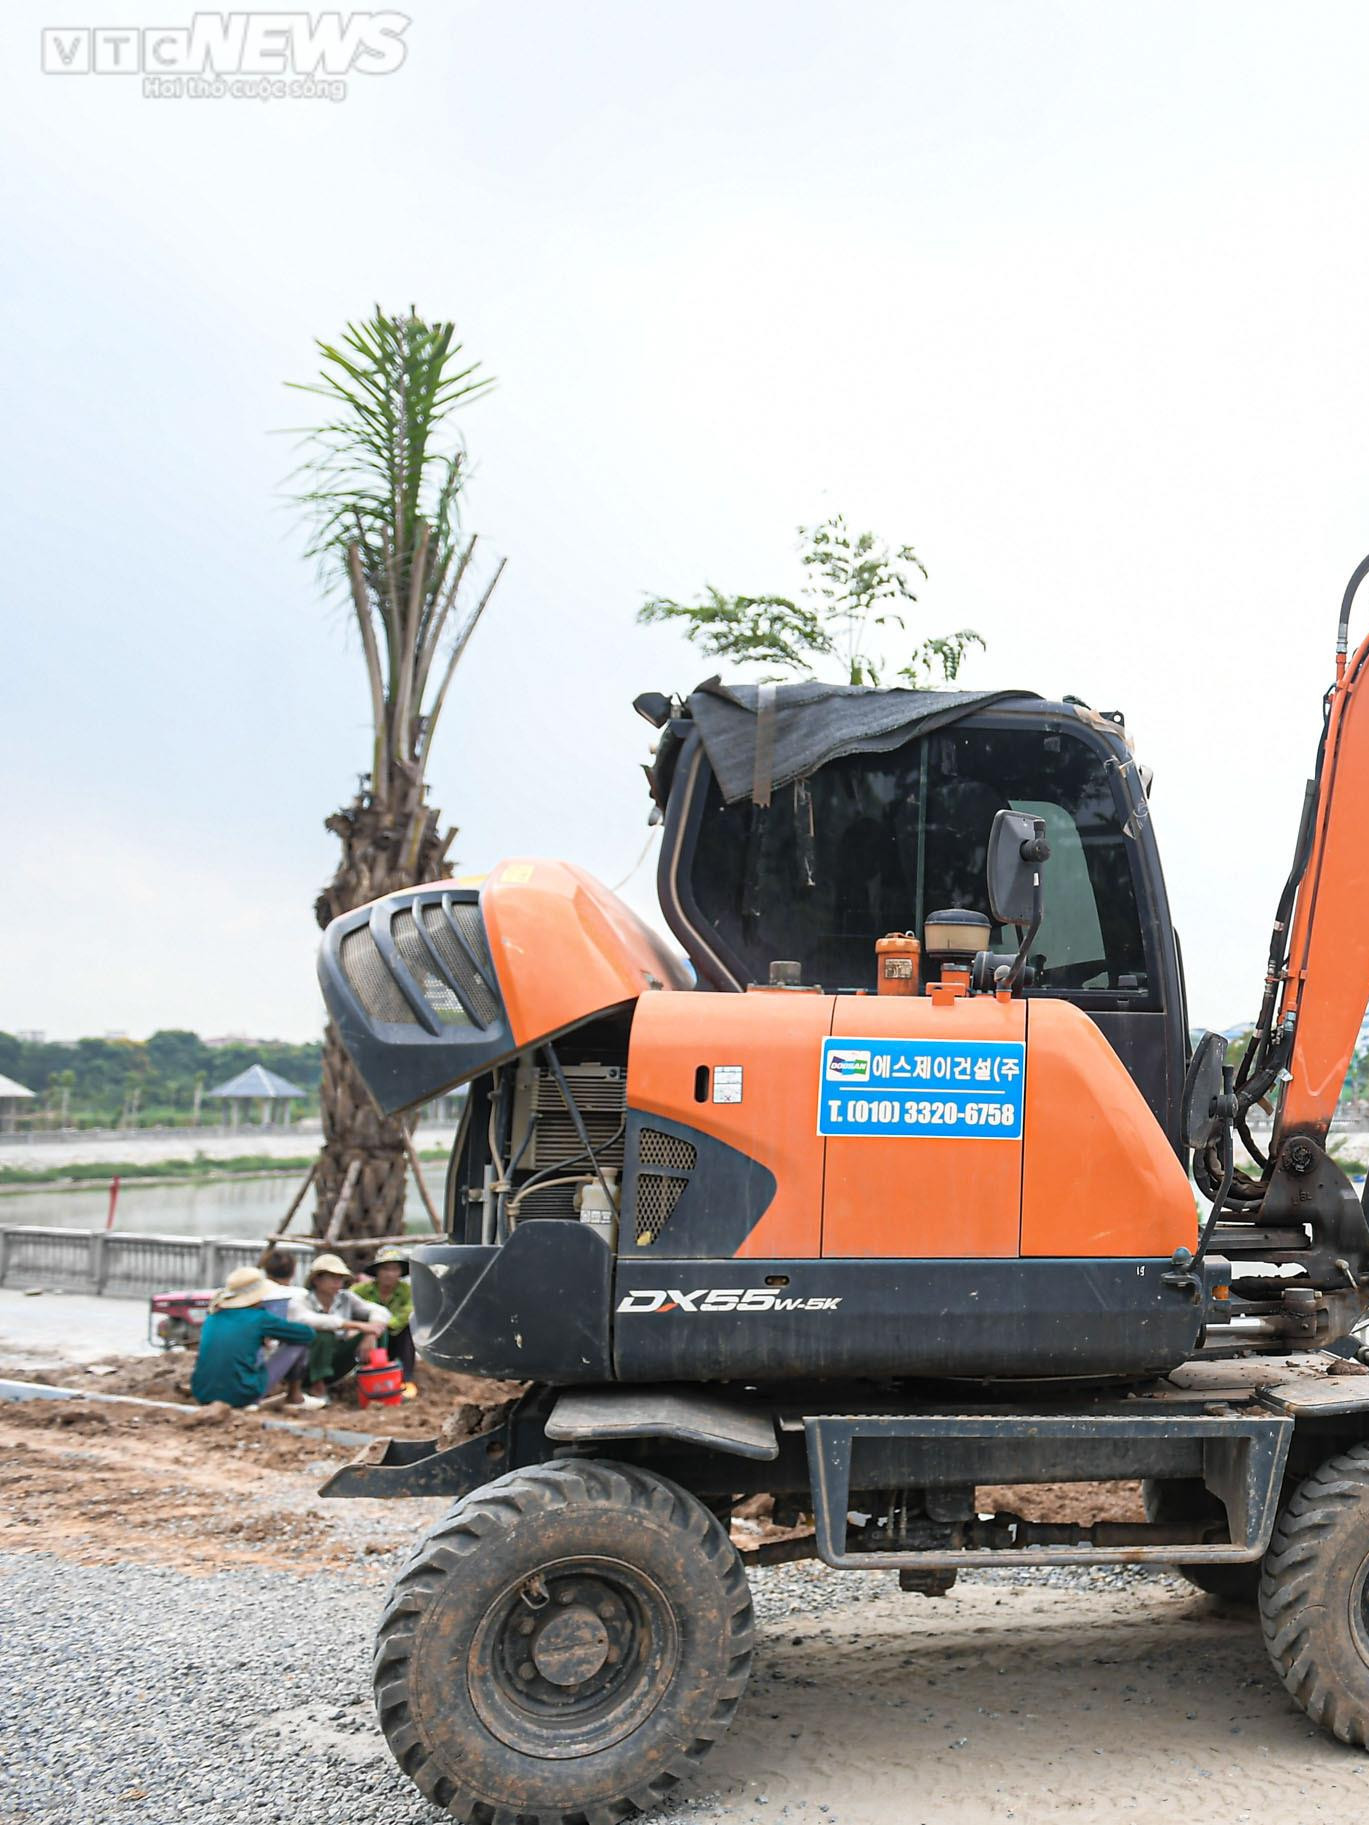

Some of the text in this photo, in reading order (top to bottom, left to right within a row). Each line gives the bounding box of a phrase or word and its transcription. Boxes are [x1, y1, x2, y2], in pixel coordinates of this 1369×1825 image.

[828, 1100, 1015, 1126] T. (010) 3320-6758
